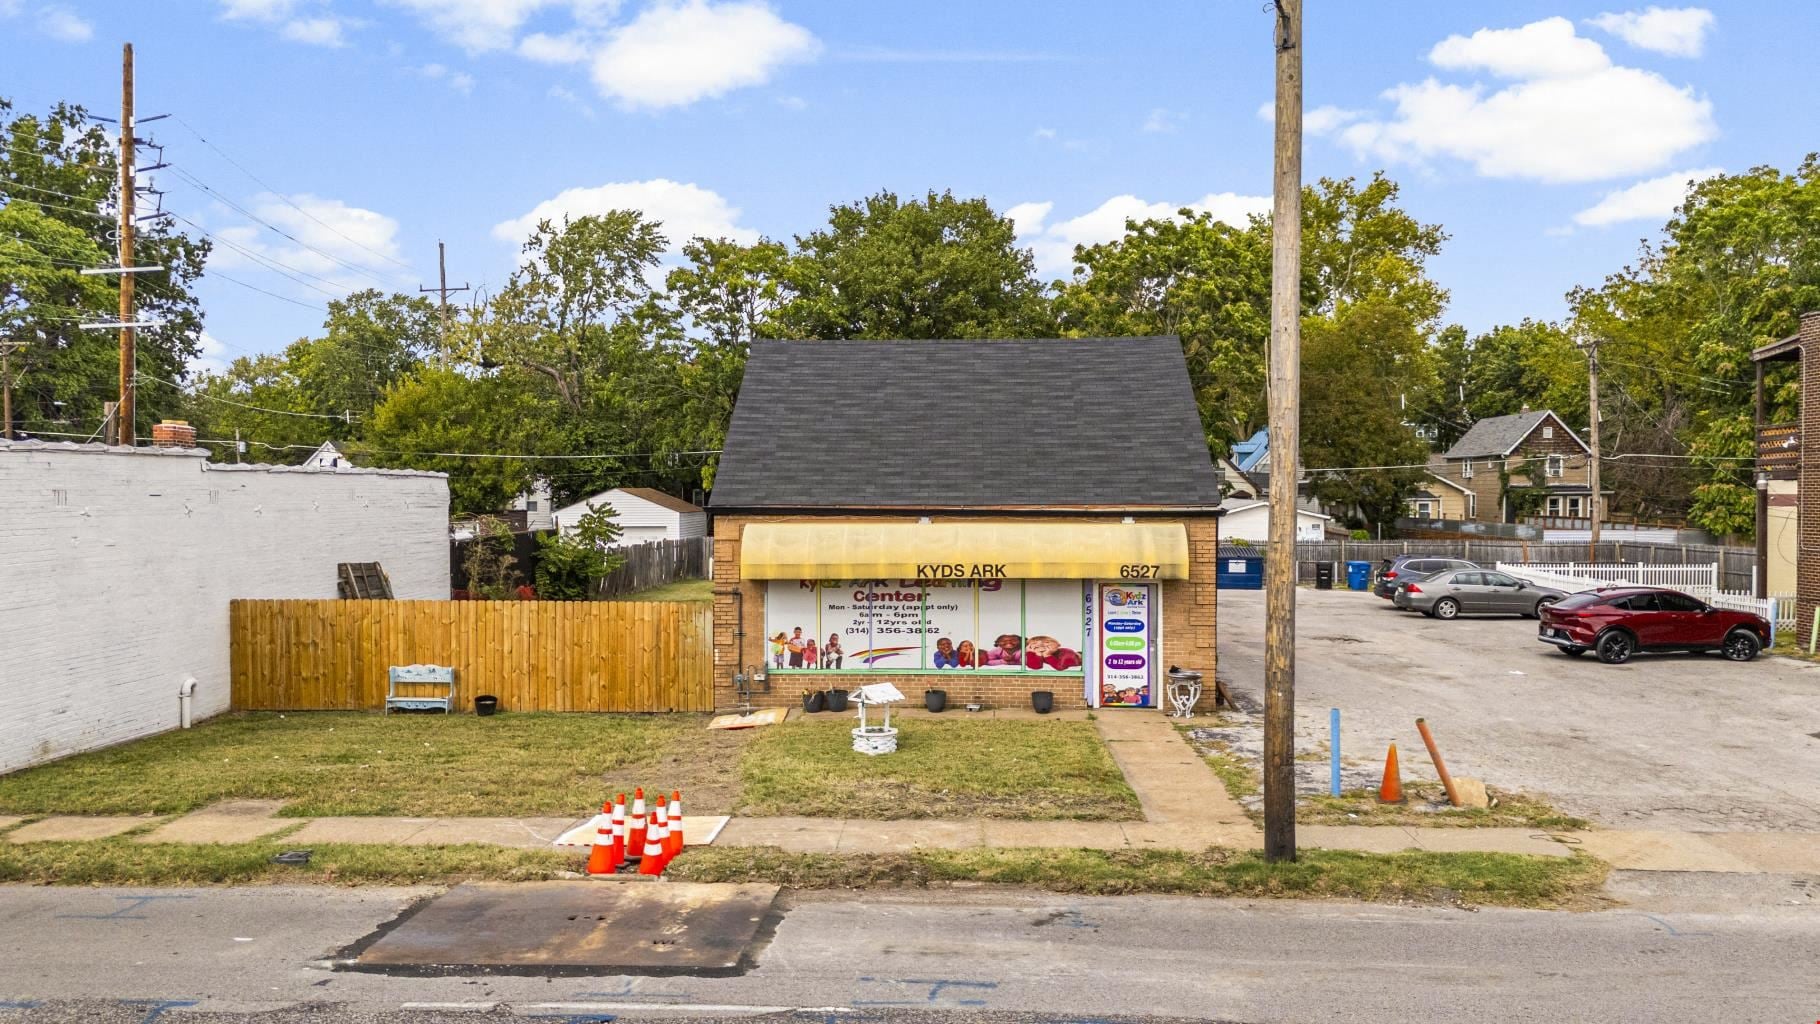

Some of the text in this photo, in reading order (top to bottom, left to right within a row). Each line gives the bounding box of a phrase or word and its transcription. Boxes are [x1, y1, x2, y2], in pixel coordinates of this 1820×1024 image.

[917, 564, 1007, 578] KYDS ARK
[1120, 565, 1160, 578] 6527
[853, 590, 931, 602] Center
[1126, 591, 1146, 600] Kydz
[845, 627, 869, 635] (314)
